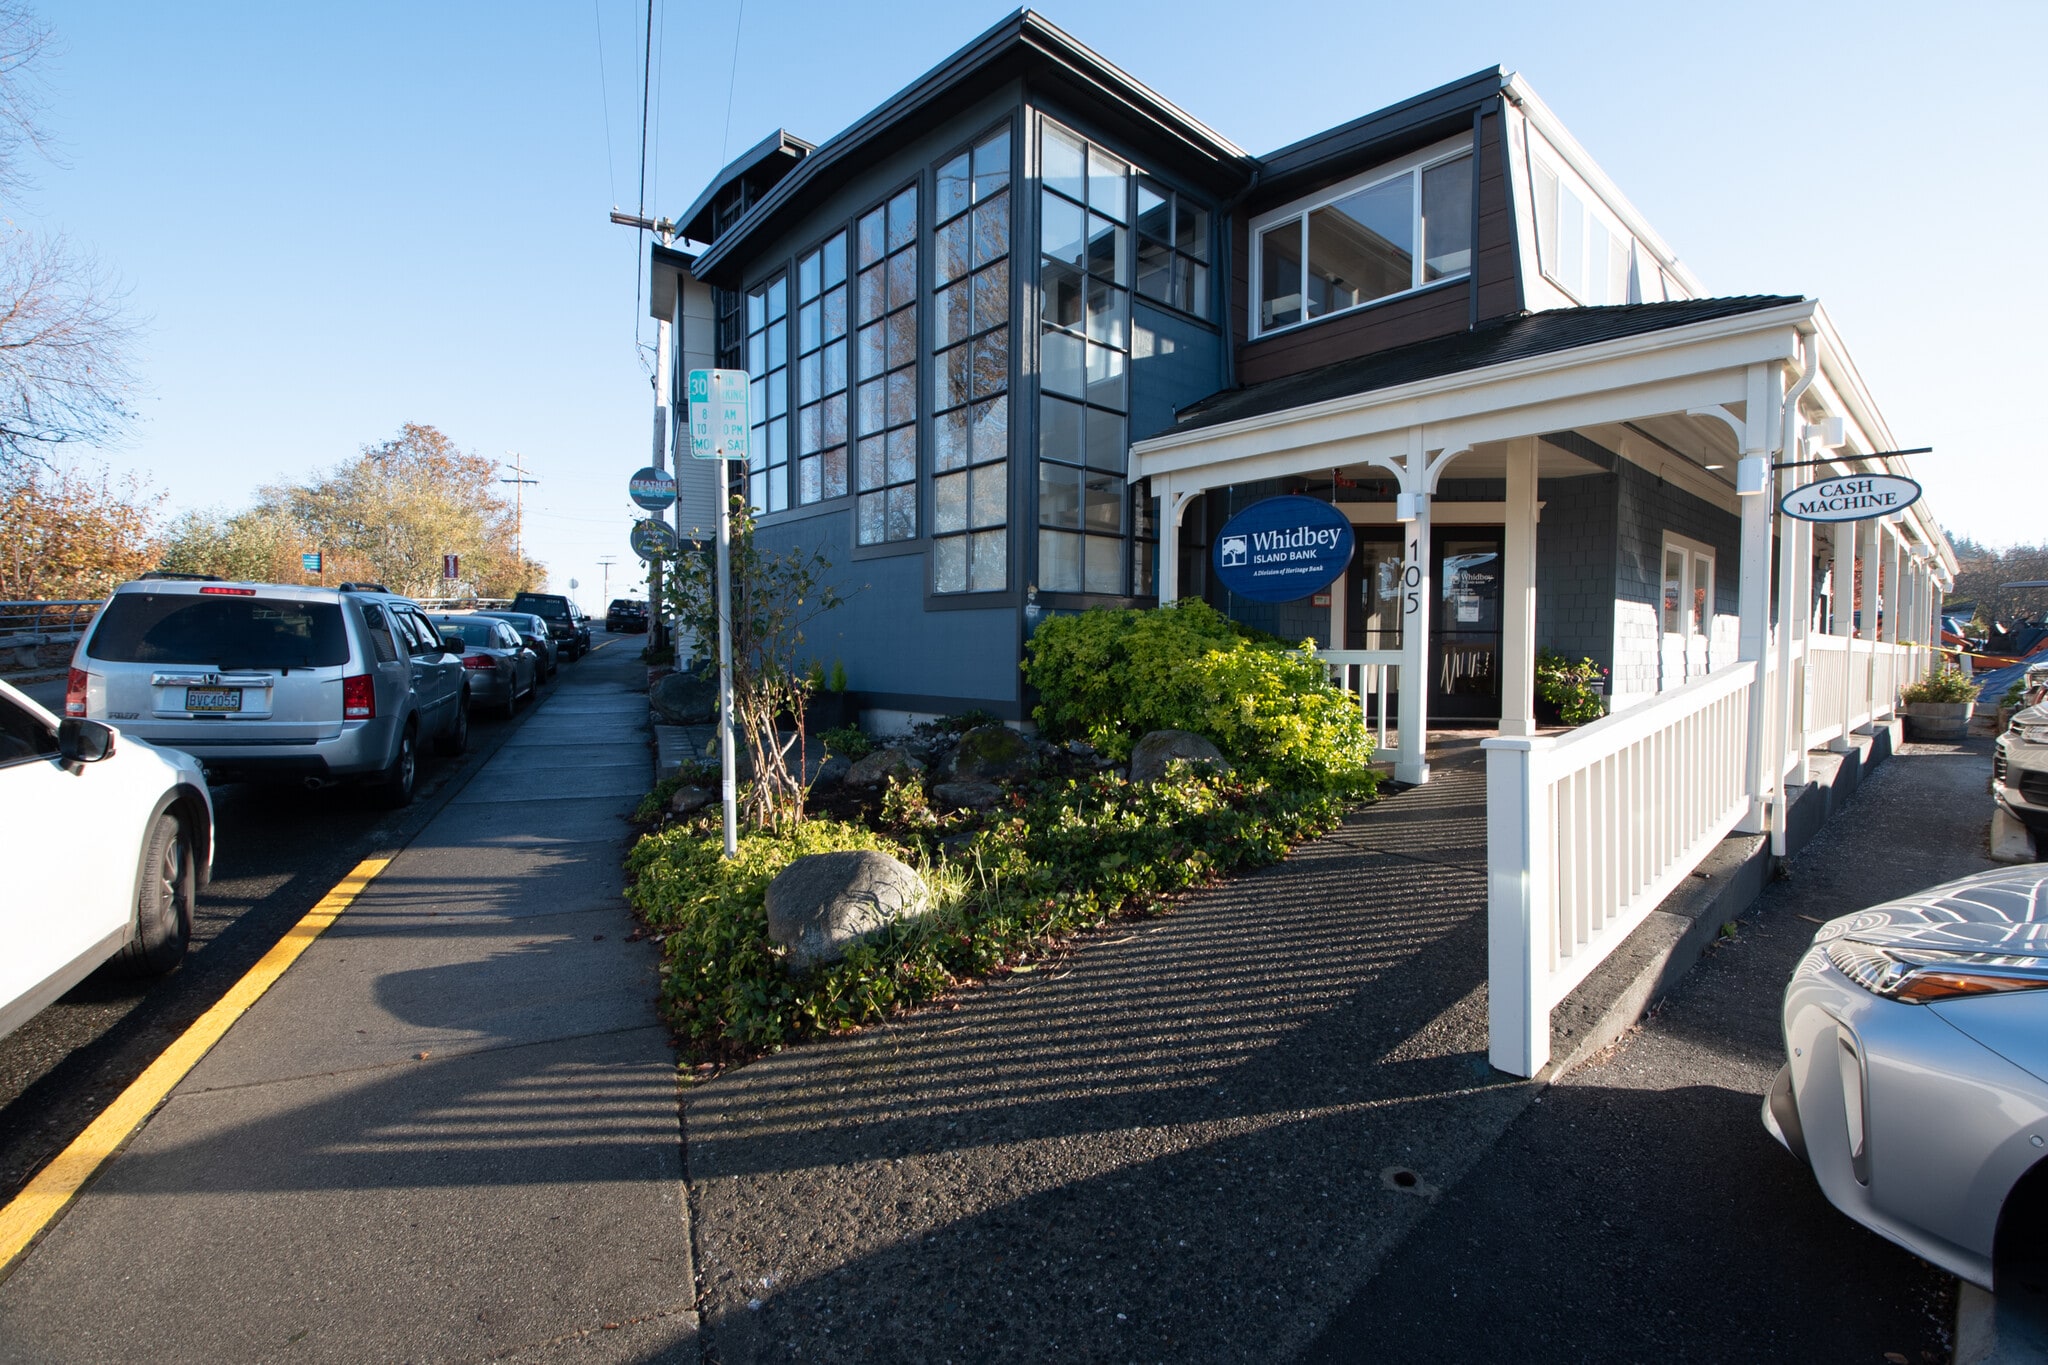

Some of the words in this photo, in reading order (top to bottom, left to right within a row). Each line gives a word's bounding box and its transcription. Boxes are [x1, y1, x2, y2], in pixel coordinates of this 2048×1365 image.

[692, 379, 707, 395] 30
[702, 408, 708, 420] 8
[724, 409, 737, 420] AM
[697, 423, 707, 435] TO
[731, 424, 743, 436] PM
[727, 439, 744, 451] SAT
[1820, 480, 1873, 498] CASH
[1798, 492, 1898, 514] MACHINE
[1252, 526, 1342, 550] Whidbey
[1253, 552, 1288, 564] ISLAND
[1289, 549, 1317, 560] BANK
[1258, 568, 1279, 576] Division
[1285, 566, 1308, 574] Heritage
[1308, 564, 1323, 572] Bank
[1405, 539, 1420, 614] 105
[190, 695, 238, 707] BVC4055
